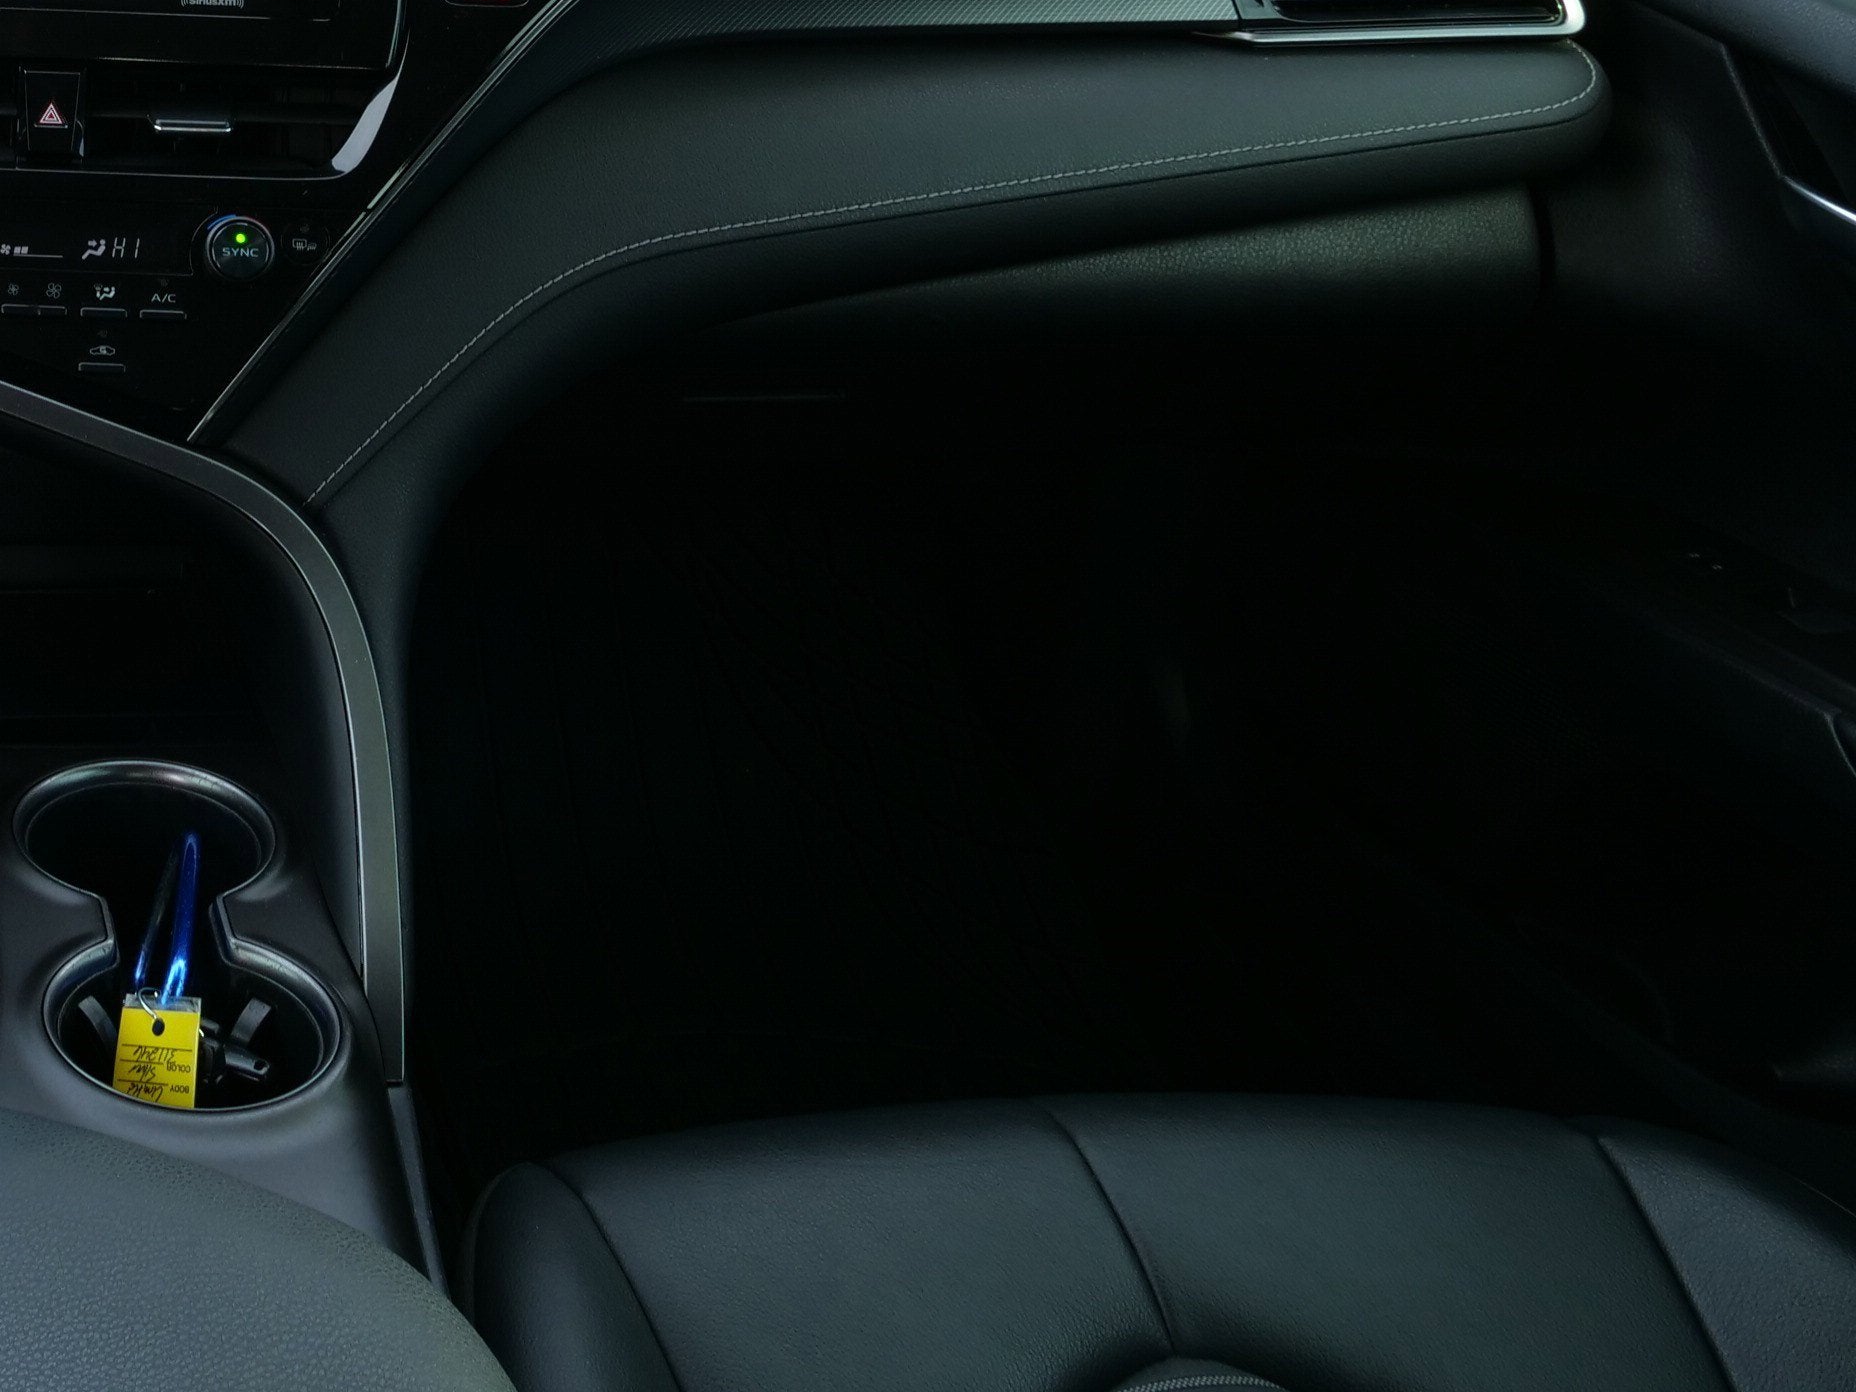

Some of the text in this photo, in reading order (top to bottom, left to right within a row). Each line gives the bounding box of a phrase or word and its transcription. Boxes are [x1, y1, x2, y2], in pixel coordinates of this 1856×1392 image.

[221, 247, 260, 258] SYNC
[150, 293, 177, 304] A/C
[166, 1061, 191, 1074] COLOR
[169, 1085, 190, 1094] BODY
